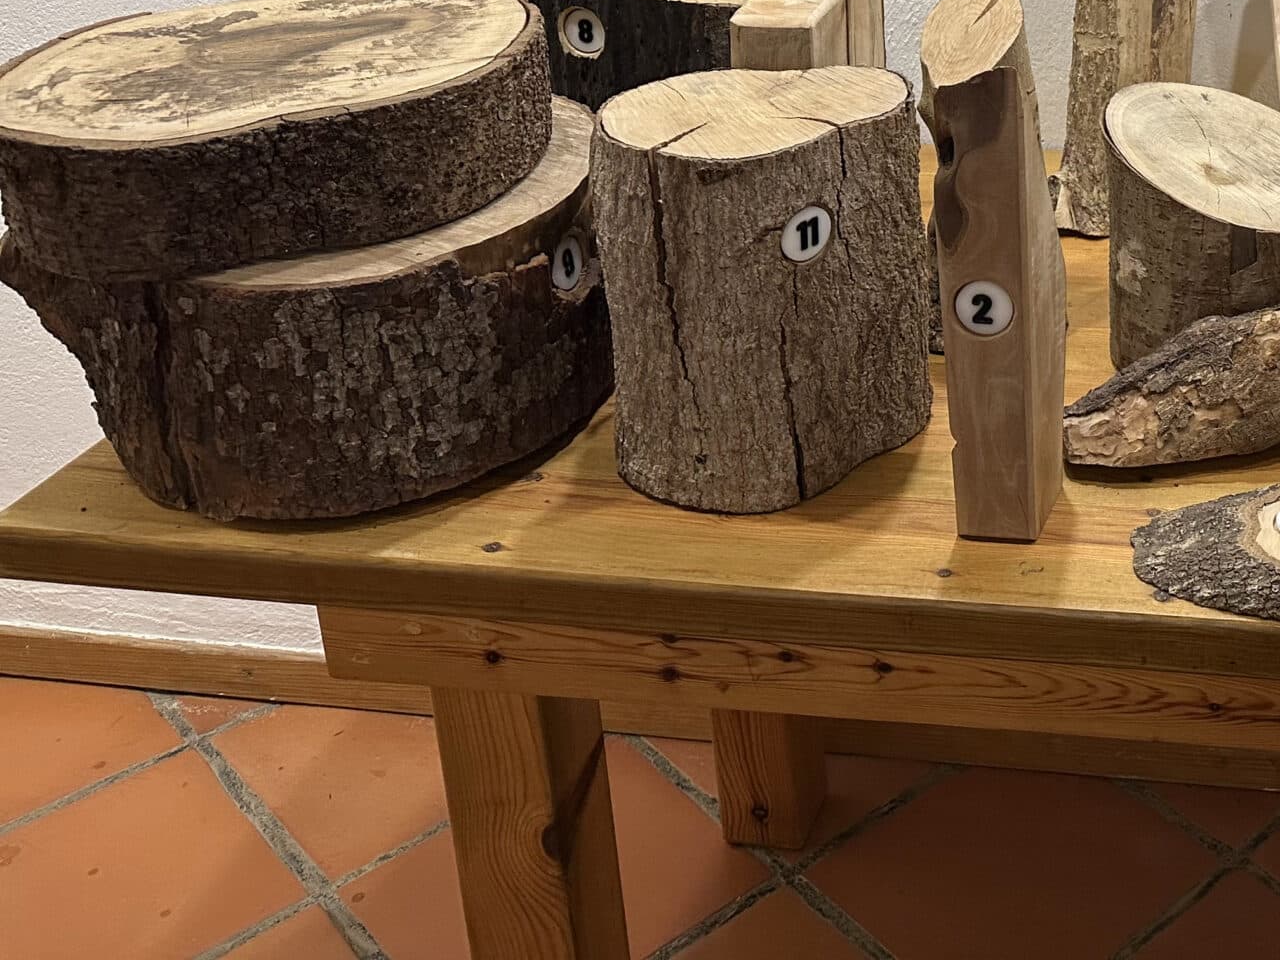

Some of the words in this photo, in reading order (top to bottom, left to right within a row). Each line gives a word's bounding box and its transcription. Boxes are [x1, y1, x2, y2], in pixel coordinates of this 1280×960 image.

[577, 21, 593, 43] 8
[796, 218, 819, 248] 11
[971, 293, 993, 323] 2
